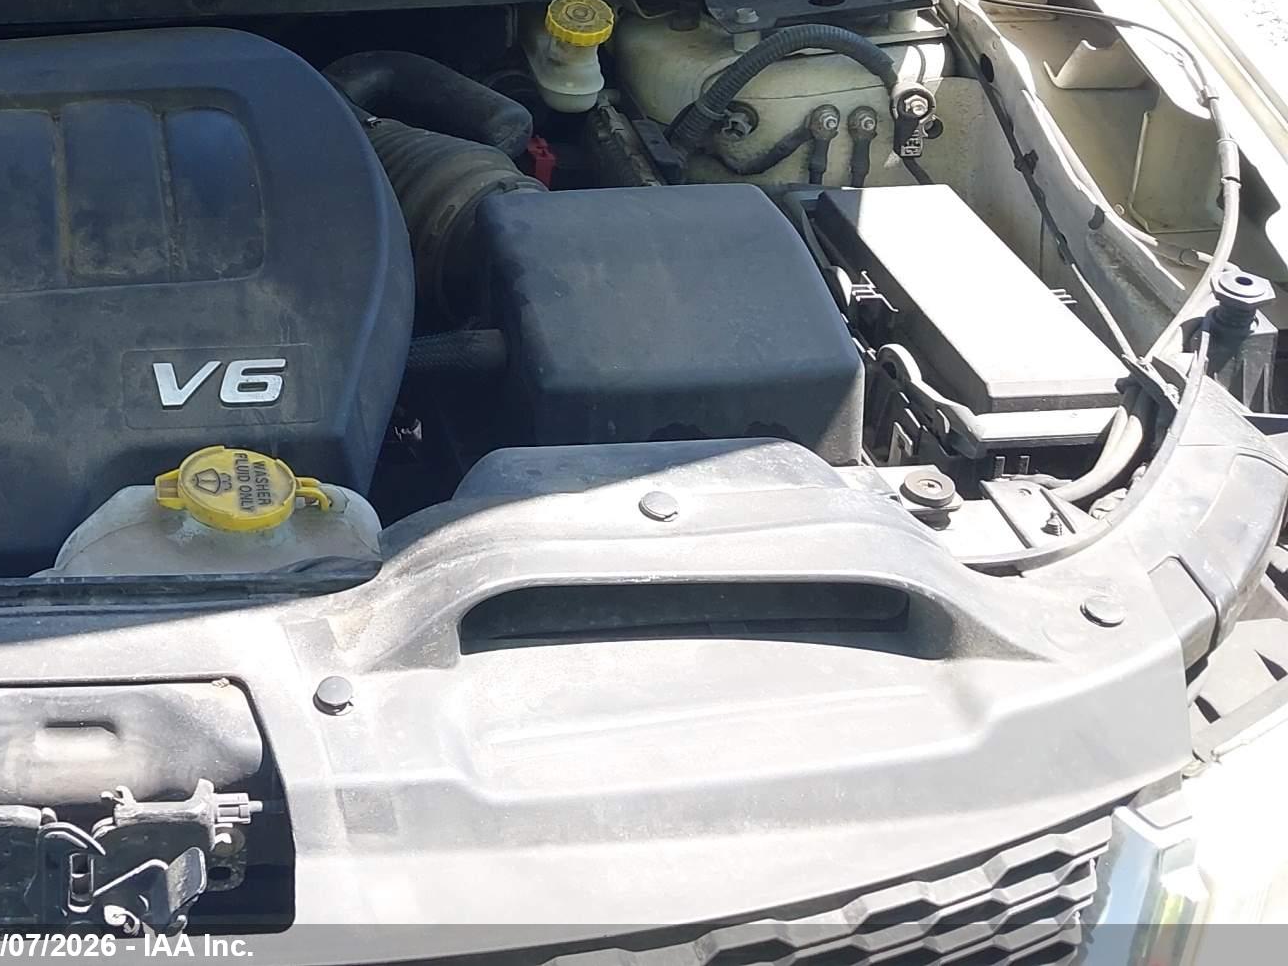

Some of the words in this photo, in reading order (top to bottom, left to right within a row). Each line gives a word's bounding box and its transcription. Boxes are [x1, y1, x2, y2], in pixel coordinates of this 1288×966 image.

[152, 357, 287, 410] V6
[234, 452, 251, 483] FLUID
[253, 460, 272, 506] WASHER
[239, 484, 255, 513] ONLY
